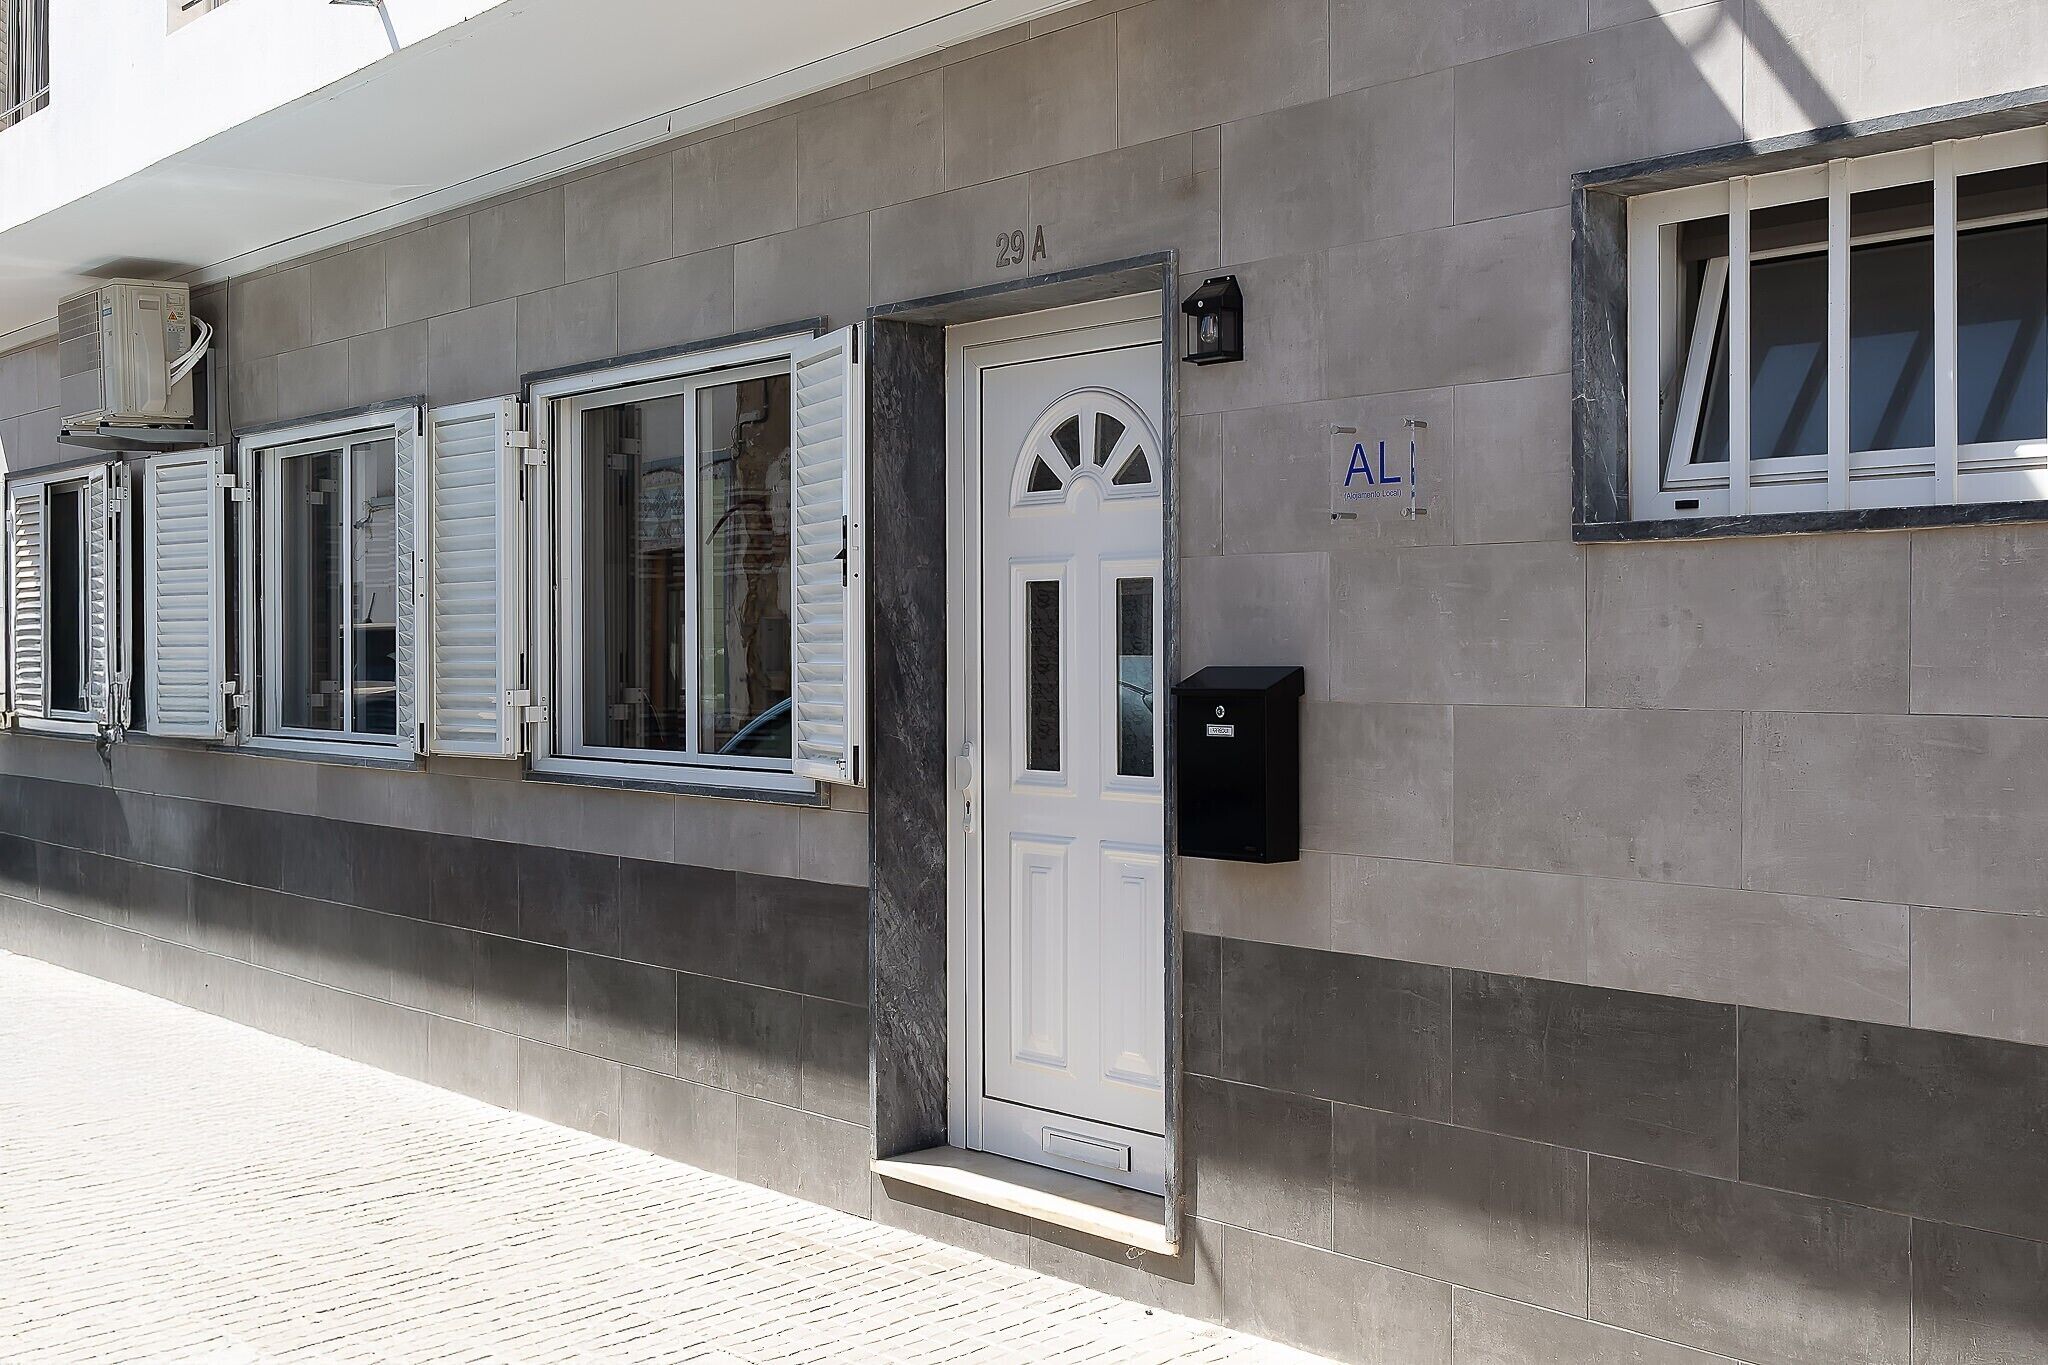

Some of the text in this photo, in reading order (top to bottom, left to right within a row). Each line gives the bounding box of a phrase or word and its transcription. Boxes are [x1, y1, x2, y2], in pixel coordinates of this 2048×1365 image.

[995, 224, 1047, 268] 29 A
[1343, 440, 1402, 487] AL
